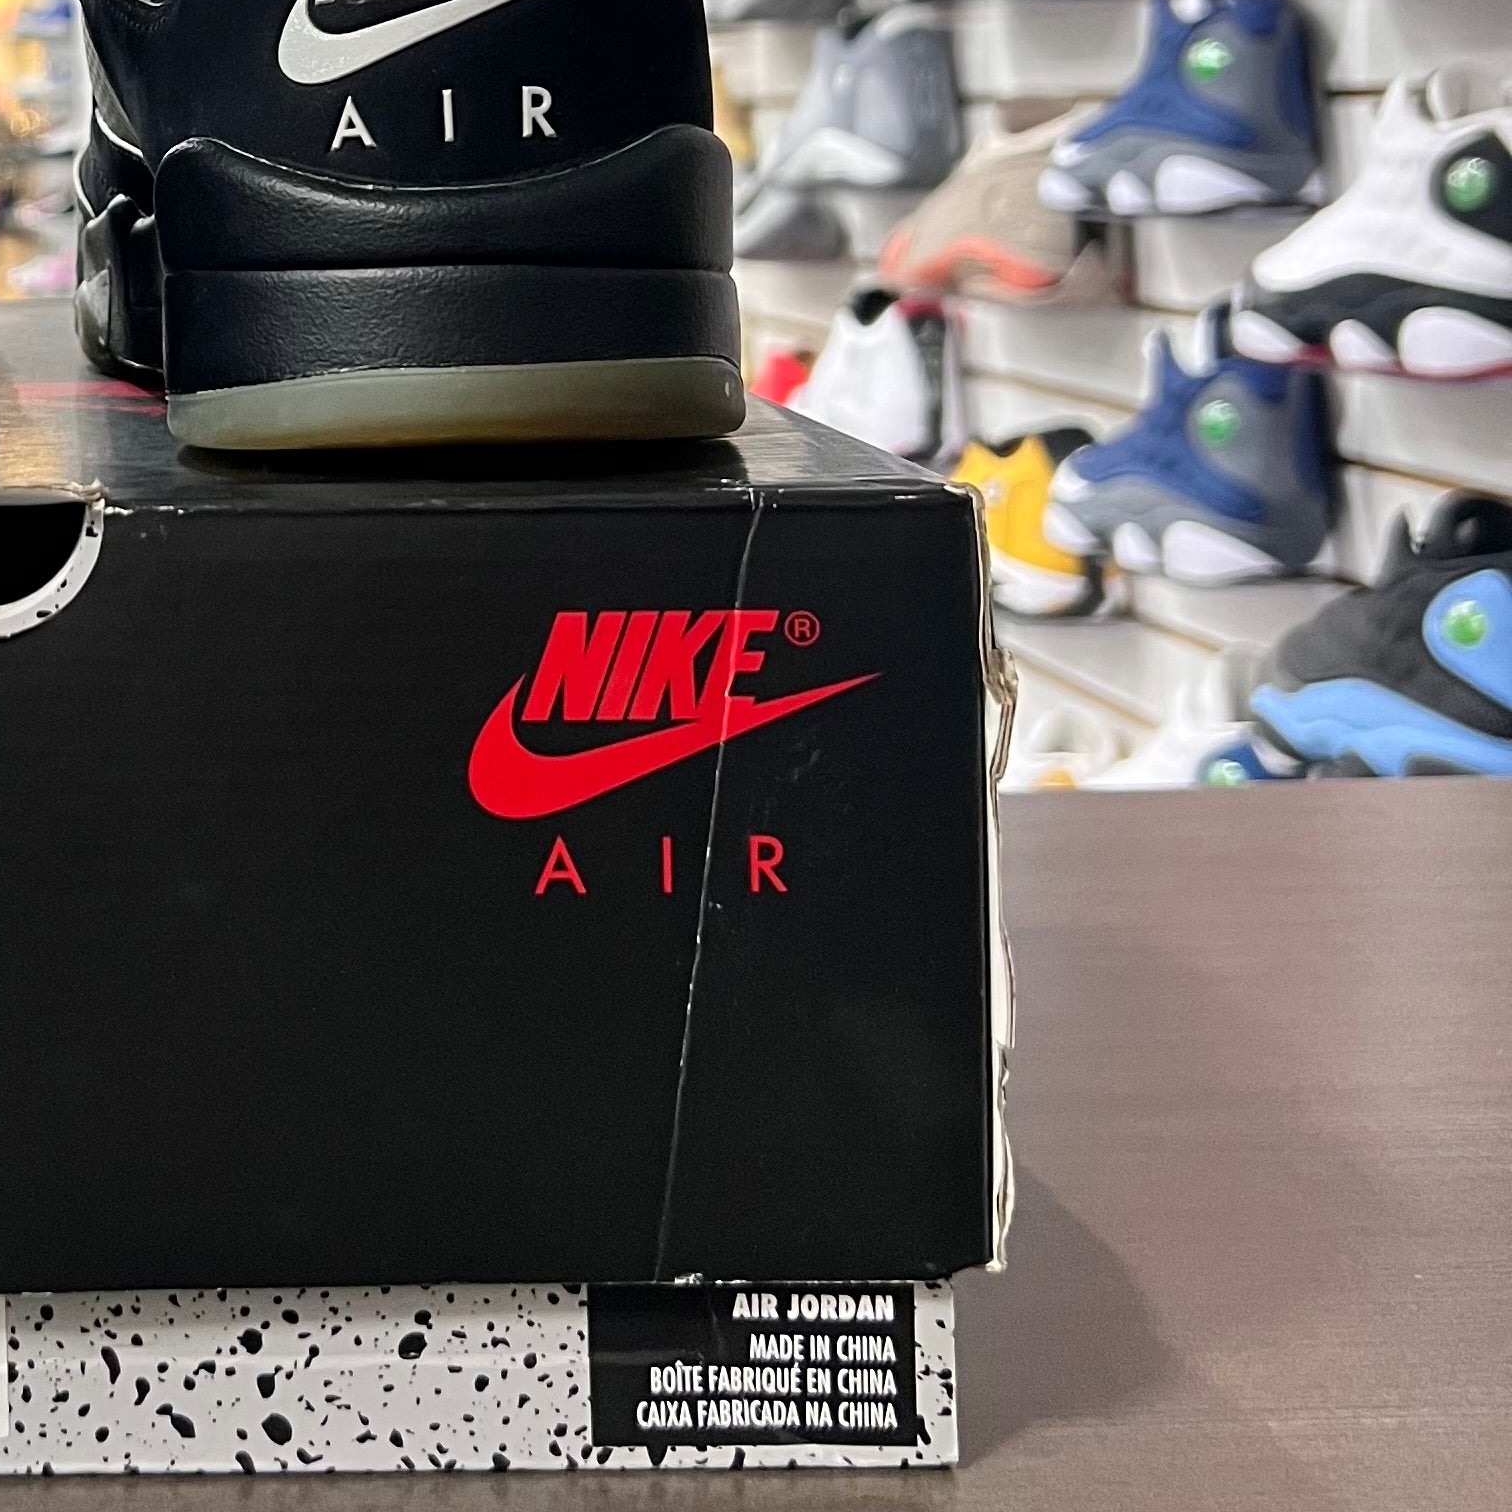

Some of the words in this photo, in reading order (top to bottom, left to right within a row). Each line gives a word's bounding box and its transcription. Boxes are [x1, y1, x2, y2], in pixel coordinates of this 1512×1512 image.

[330, 85, 558, 152] AIR
[533, 835, 788, 895] AIR
[732, 1292, 780, 1320] AIR
[787, 1293, 895, 1321] JORDAN
[749, 1333, 805, 1361] MADE
[810, 1334, 830, 1361] IN
[837, 1335, 897, 1362] CHINA
[650, 1359, 704, 1395] BOÎTE
[708, 1362, 802, 1395] FABRIQUÉ
[807, 1367, 831, 1394] EN
[837, 1367, 897, 1395] CHINA
[636, 1400, 693, 1428] CAIXA
[697, 1399, 801, 1428] FABRICADA
[805, 1400, 833, 1428] NA
[838, 1401, 898, 1429] CHINA
